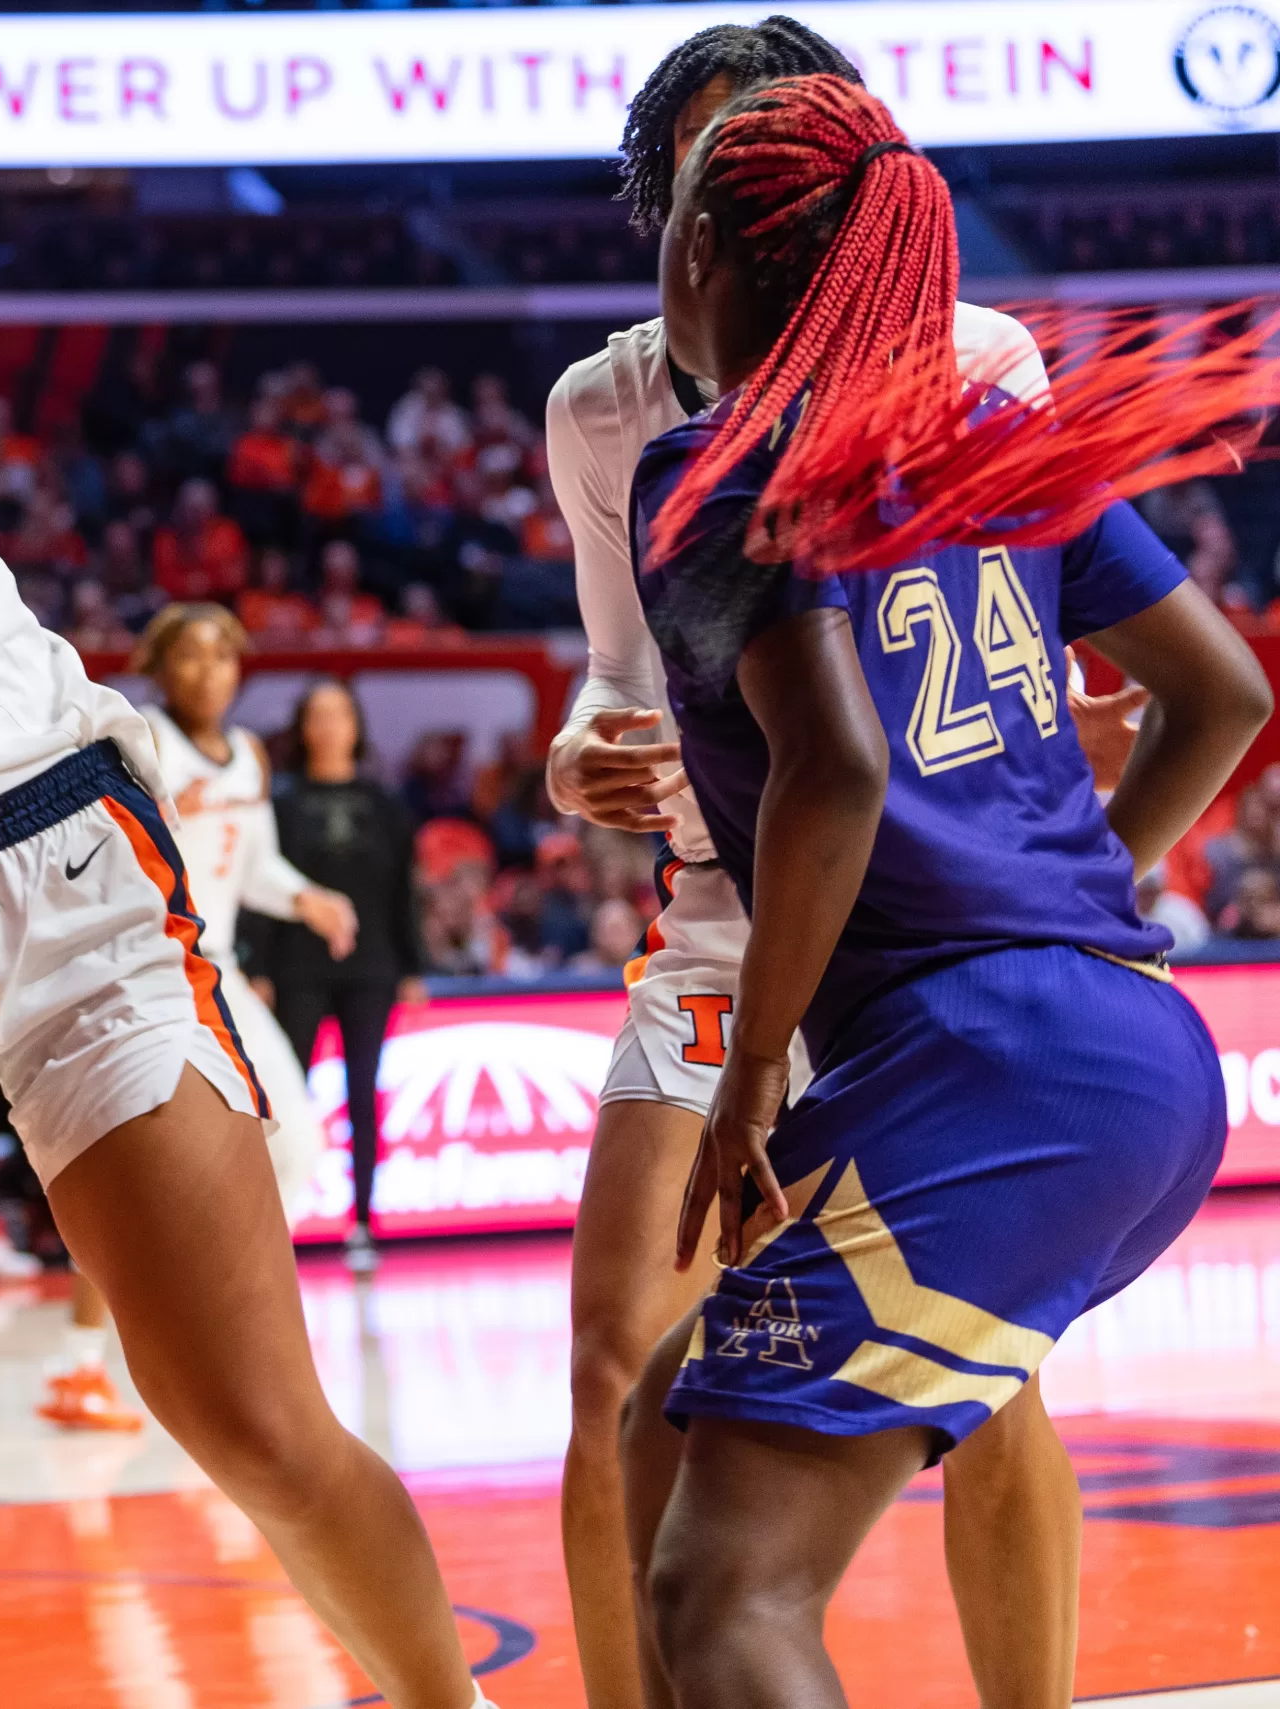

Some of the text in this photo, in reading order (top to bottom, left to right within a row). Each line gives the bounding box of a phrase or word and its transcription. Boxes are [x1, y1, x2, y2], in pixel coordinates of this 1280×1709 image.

[211, 54, 334, 122] UP
[372, 48, 628, 117] WITH
[858, 37, 1095, 106] TEIN
[877, 545, 1059, 778] 24
[677, 993, 734, 1068] I
